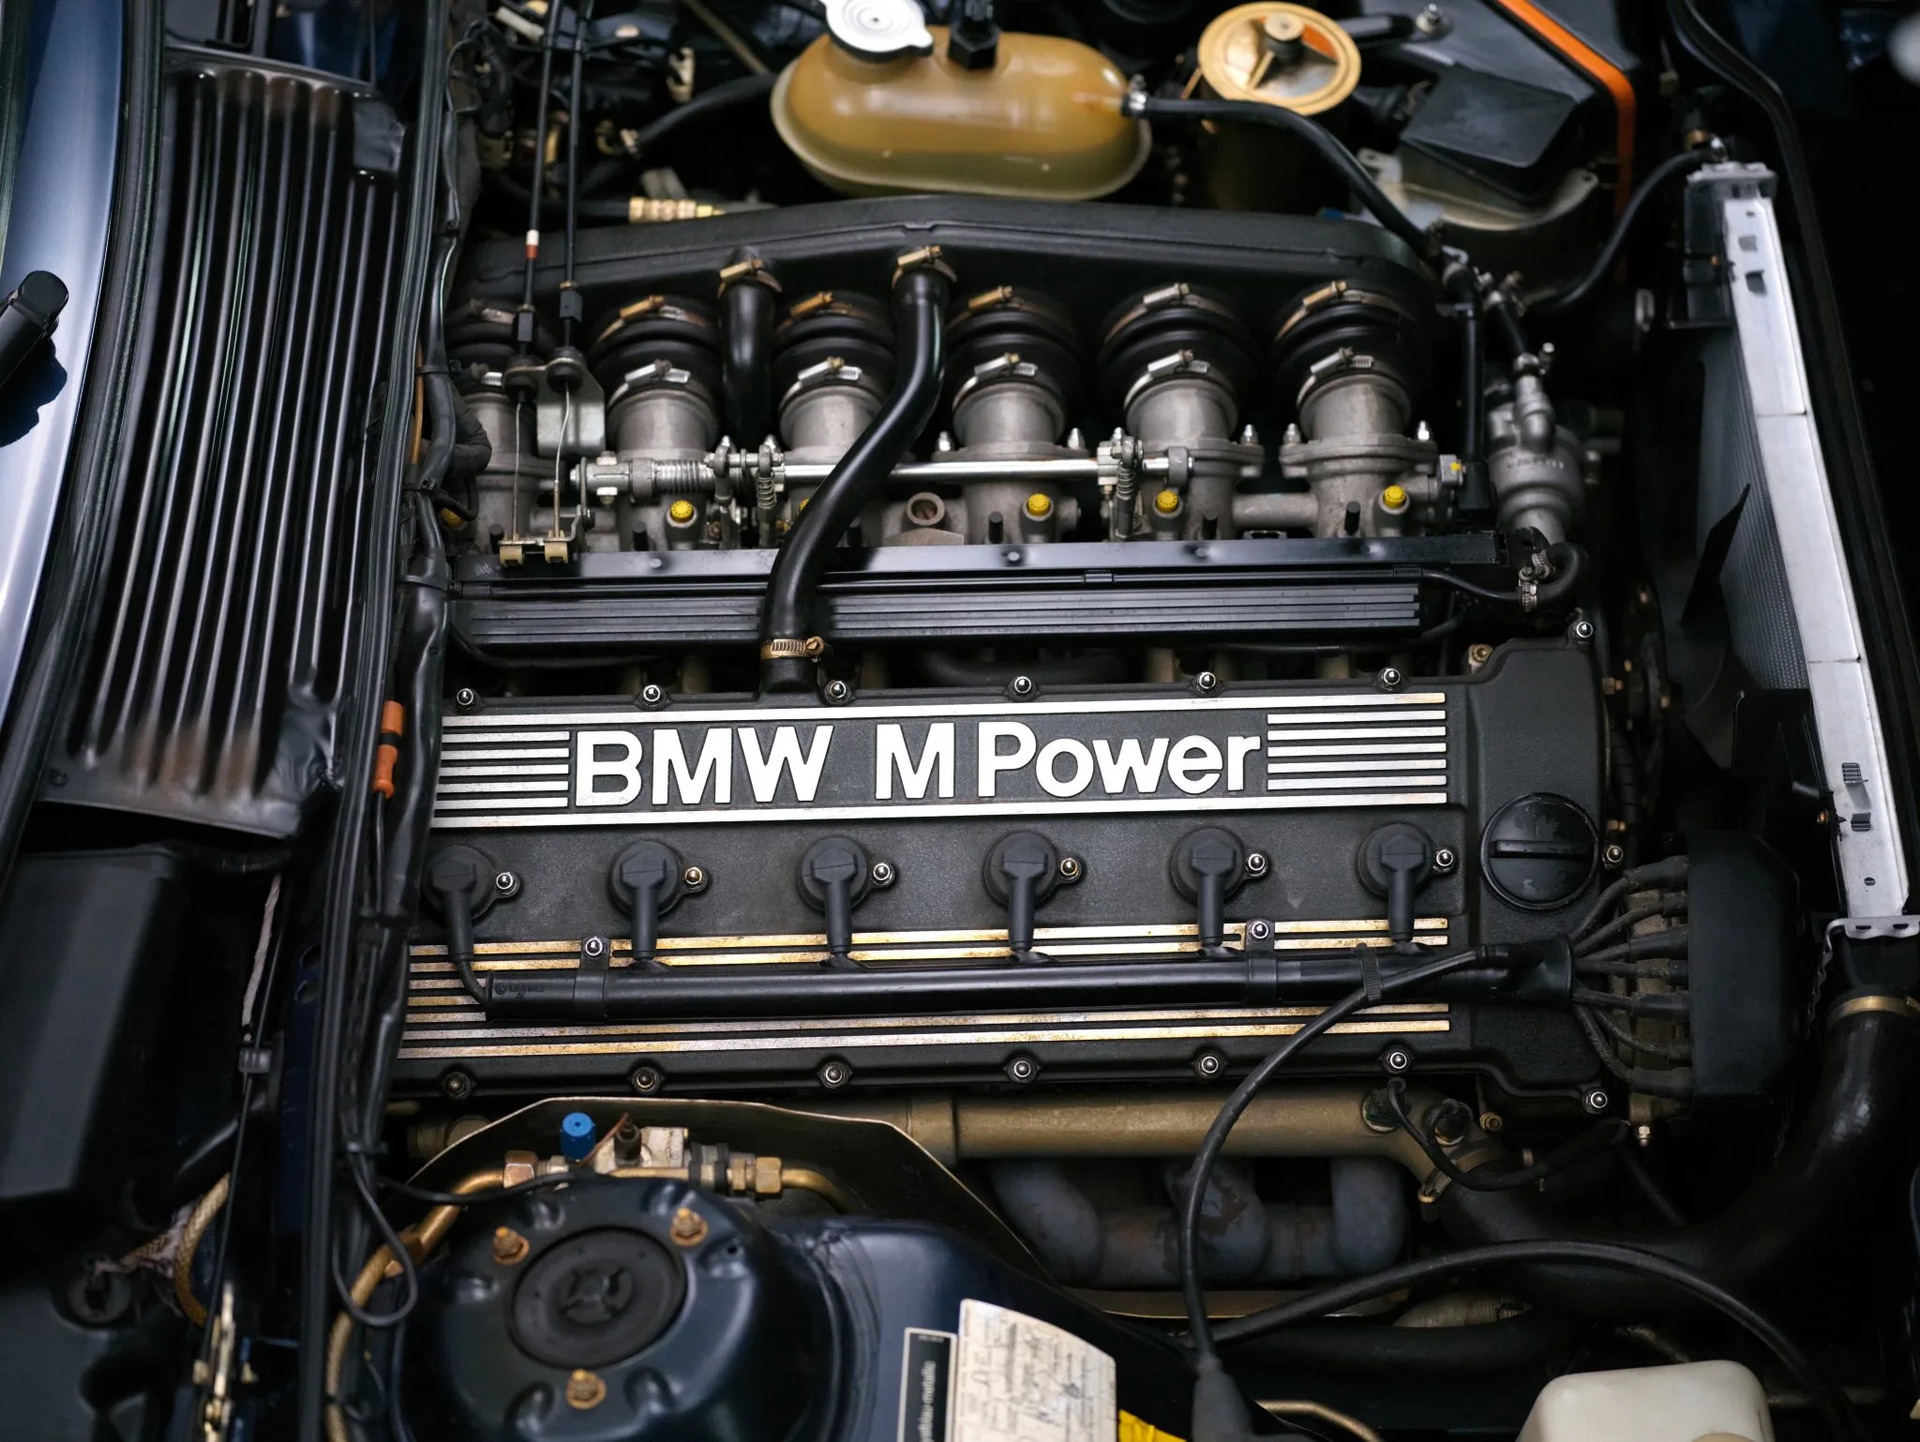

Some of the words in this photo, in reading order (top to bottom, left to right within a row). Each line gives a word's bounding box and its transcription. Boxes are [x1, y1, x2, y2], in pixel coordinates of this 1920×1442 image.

[575, 725, 834, 807] BMW
[875, 722, 956, 800] M
[976, 721, 1262, 798] Power
